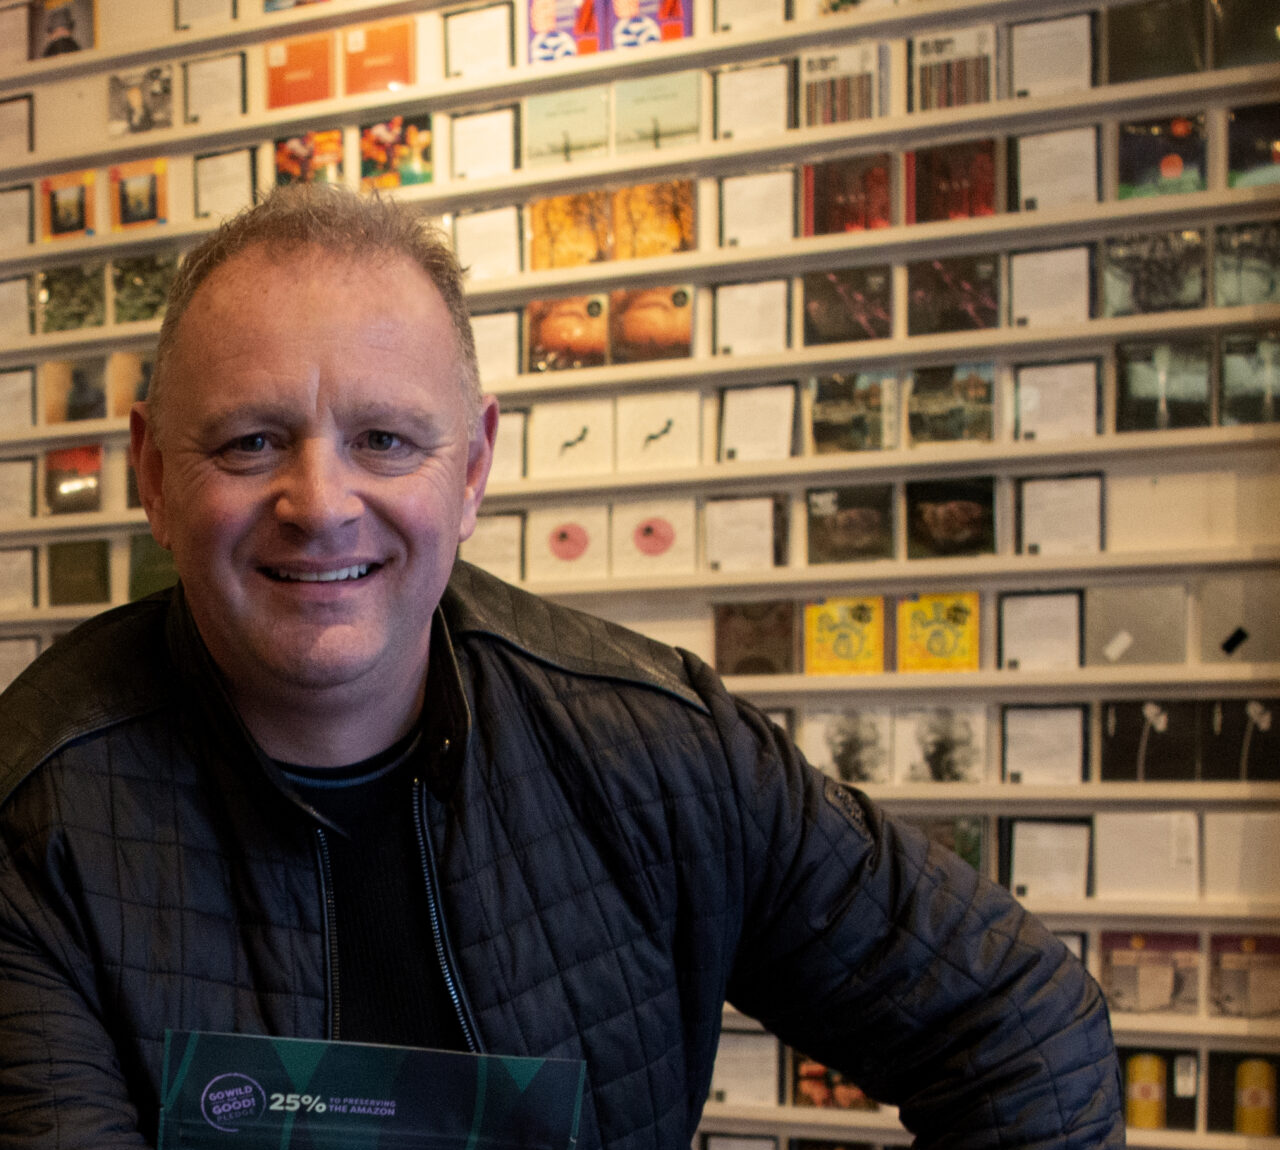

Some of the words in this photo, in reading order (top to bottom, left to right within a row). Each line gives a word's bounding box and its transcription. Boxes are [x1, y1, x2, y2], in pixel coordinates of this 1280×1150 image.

[212, 1097, 256, 1115] GOOD!
[270, 1093, 327, 1113] 25%
[329, 1104, 347, 1113] THE
[349, 1106, 396, 1116] AMAZON
